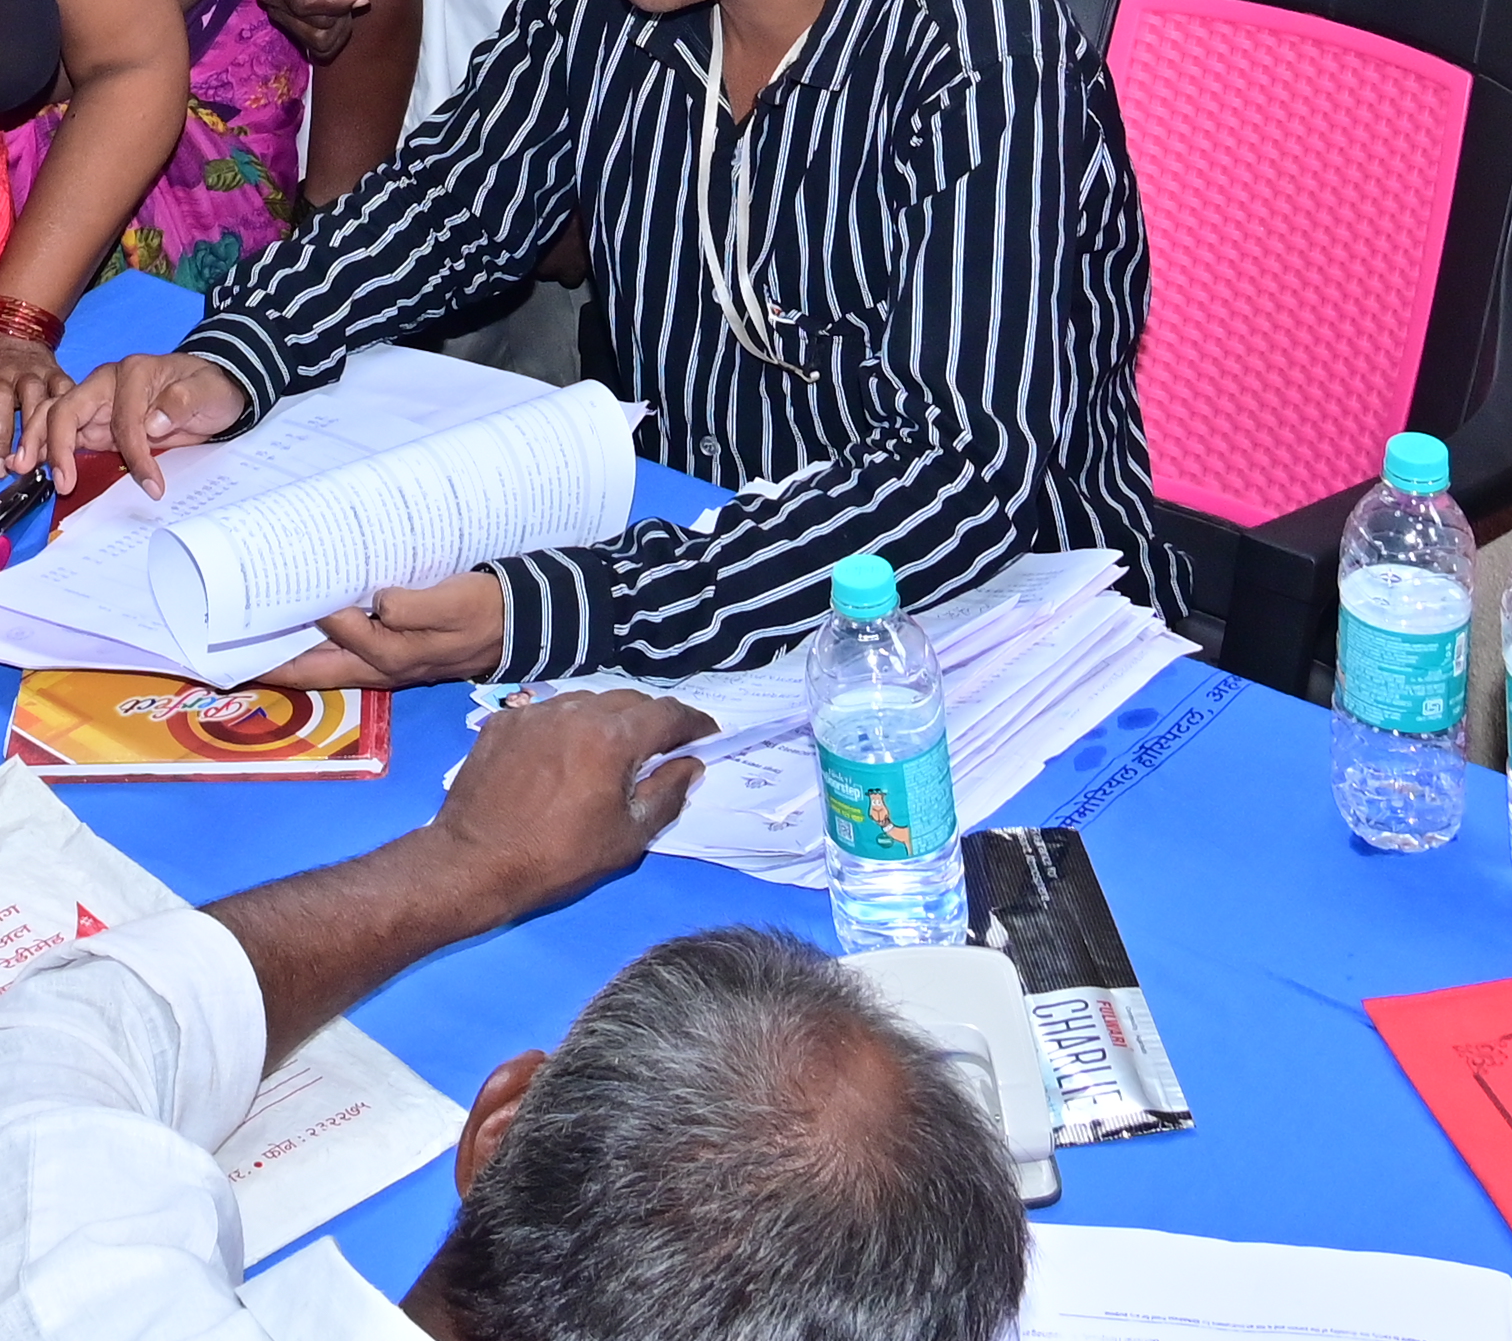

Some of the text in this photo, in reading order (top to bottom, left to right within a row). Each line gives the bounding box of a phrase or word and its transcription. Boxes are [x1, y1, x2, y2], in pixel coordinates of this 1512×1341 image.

[117, 688, 256, 720] Perfect
[1095, 999, 1128, 1049] FULWARI
[1032, 998, 1125, 1112] CHARLIE
[261, 1138, 298, 1160] फोन
